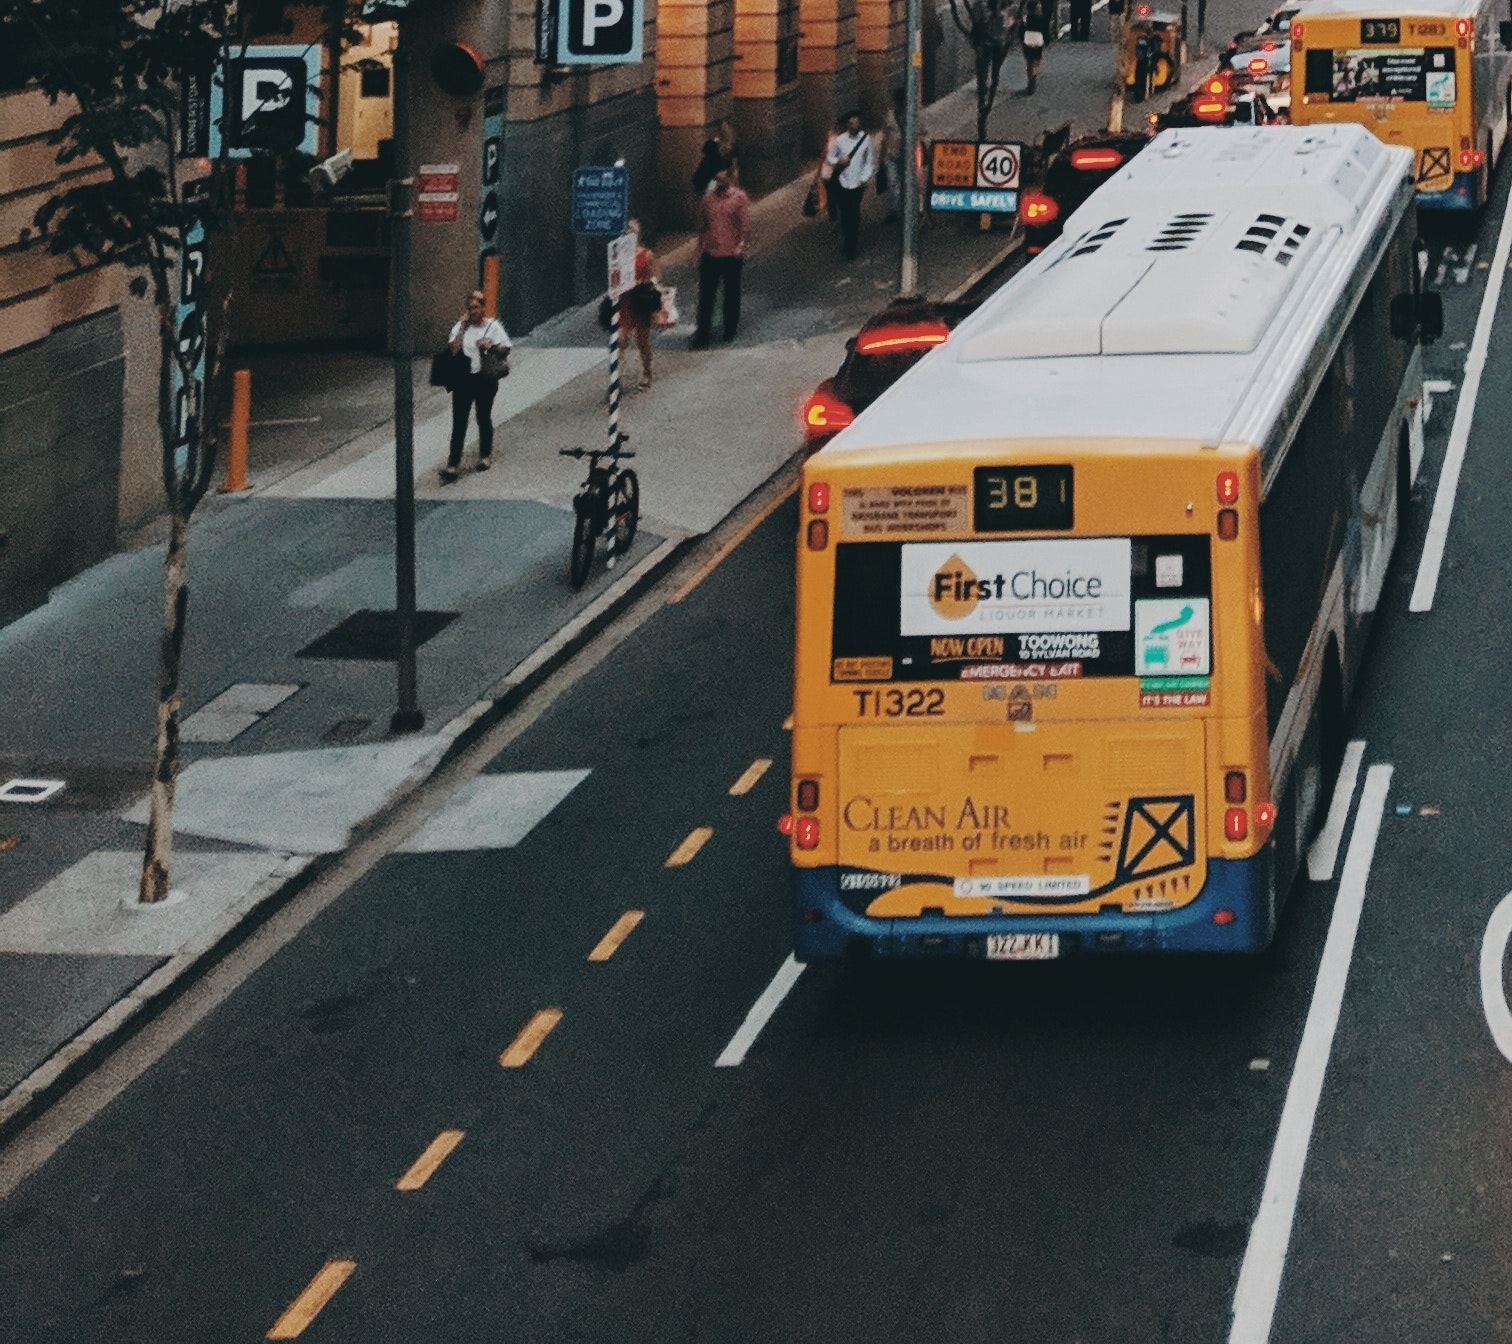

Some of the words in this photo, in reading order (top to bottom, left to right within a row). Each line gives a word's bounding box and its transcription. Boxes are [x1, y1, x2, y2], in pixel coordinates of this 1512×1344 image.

[1365, 22, 1398, 38] 379
[241, 68, 293, 135] P
[938, 160, 971, 170] ROAD
[985, 156, 1013, 177] 40
[931, 191, 965, 207] DRIVE
[970, 191, 1017, 208] SAFELY
[987, 475, 1067, 510] 381
[933, 570, 1006, 603] First
[1011, 570, 1102, 600] Choice
[979, 607, 1037, 622] LIQUOR
[1044, 606, 1105, 620] MARKET
[1018, 634, 1099, 651] TOOWONG
[1176, 629, 1202, 639] GIVE
[931, 637, 964, 656] NOW
[967, 636, 1004, 655] OPEN
[1178, 639, 1202, 649] WAY
[1029, 649, 1070, 660] SYLVAN
[1071, 648, 1100, 659] ROAD
[853, 688, 945, 718] T1322
[1142, 694, 1160, 706] IT'S
[1162, 694, 1182, 705] THE
[1184, 693, 1208, 705] LAW
[868, 837, 880, 853] a
[887, 832, 954, 853] breath
[961, 831, 982, 852] of
[991, 831, 1050, 852] fresh
[1058, 832, 1088, 851] air
[997, 880, 1033, 891] SPEED
[1039, 879, 1082, 890] LIMITED
